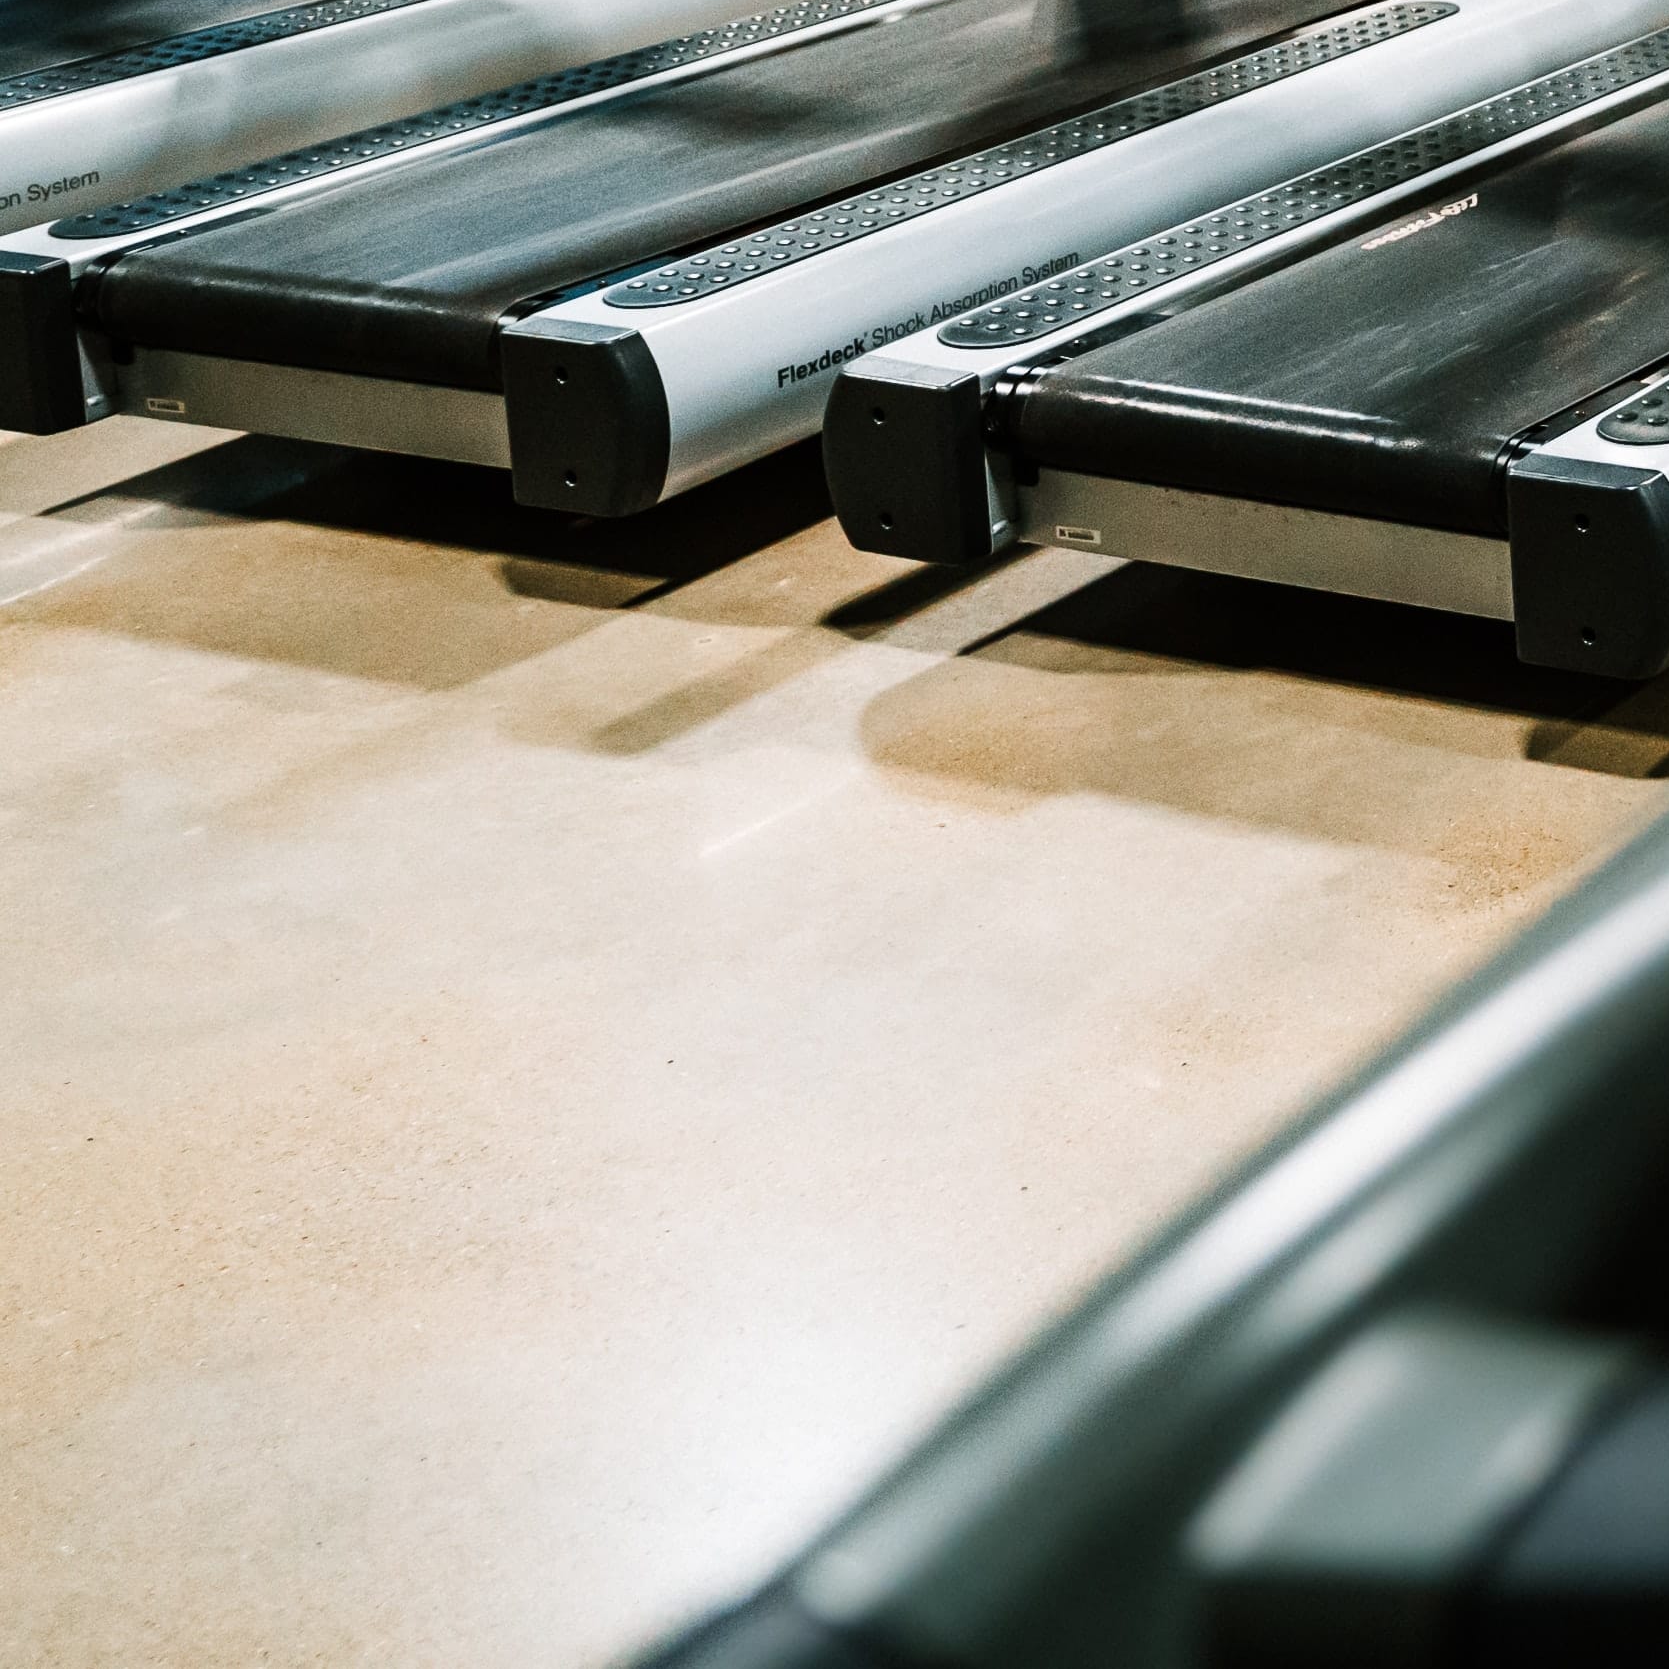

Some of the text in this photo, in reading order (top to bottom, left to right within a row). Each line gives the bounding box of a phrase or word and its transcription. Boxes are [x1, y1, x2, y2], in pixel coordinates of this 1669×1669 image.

[0, 171, 100, 210] on System
[776, 251, 1080, 389] Flexdeck Shock Absorption System
